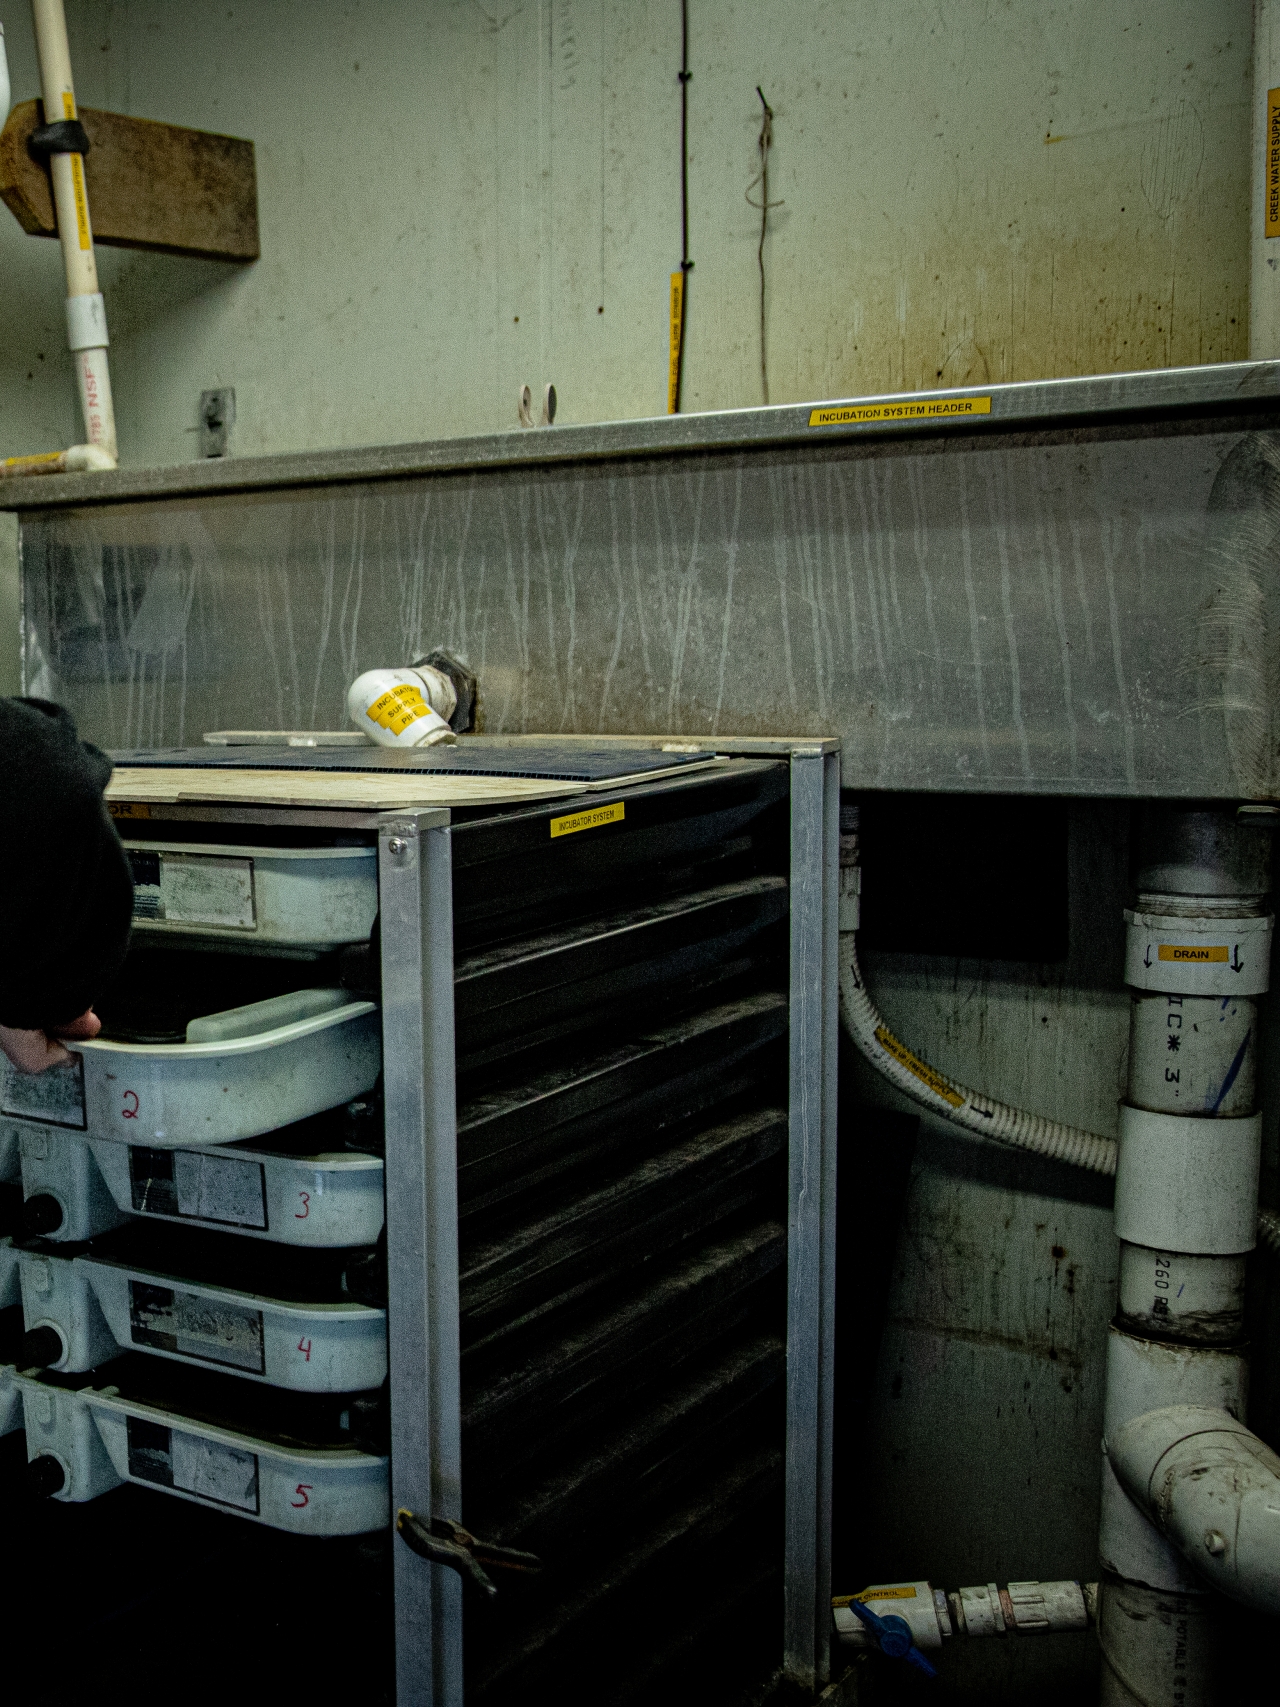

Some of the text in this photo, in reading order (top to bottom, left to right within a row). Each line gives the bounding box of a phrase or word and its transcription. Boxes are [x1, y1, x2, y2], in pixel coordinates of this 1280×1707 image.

[1270, 106, 1280, 222] CREEK WATER SUPPLY
[86, 368, 99, 407] NSF
[819, 403, 972, 422] INCUBATION SYSTEM HEADER
[388, 697, 416, 718] SUPPLY
[401, 710, 420, 724] PIPE
[559, 810, 615, 831] INCUBATOR SYSTEM
[1174, 950, 1209, 959] DRAIN
[122, 1090, 139, 1119] 2
[295, 1192, 310, 1218] 3
[1154, 1259, 1170, 1289] 260
[298, 1336, 311, 1361] 4
[291, 1484, 313, 1508] 5
[864, 1589, 900, 1600] CONTROL
[1174, 1620, 1187, 1669] POTABLE
